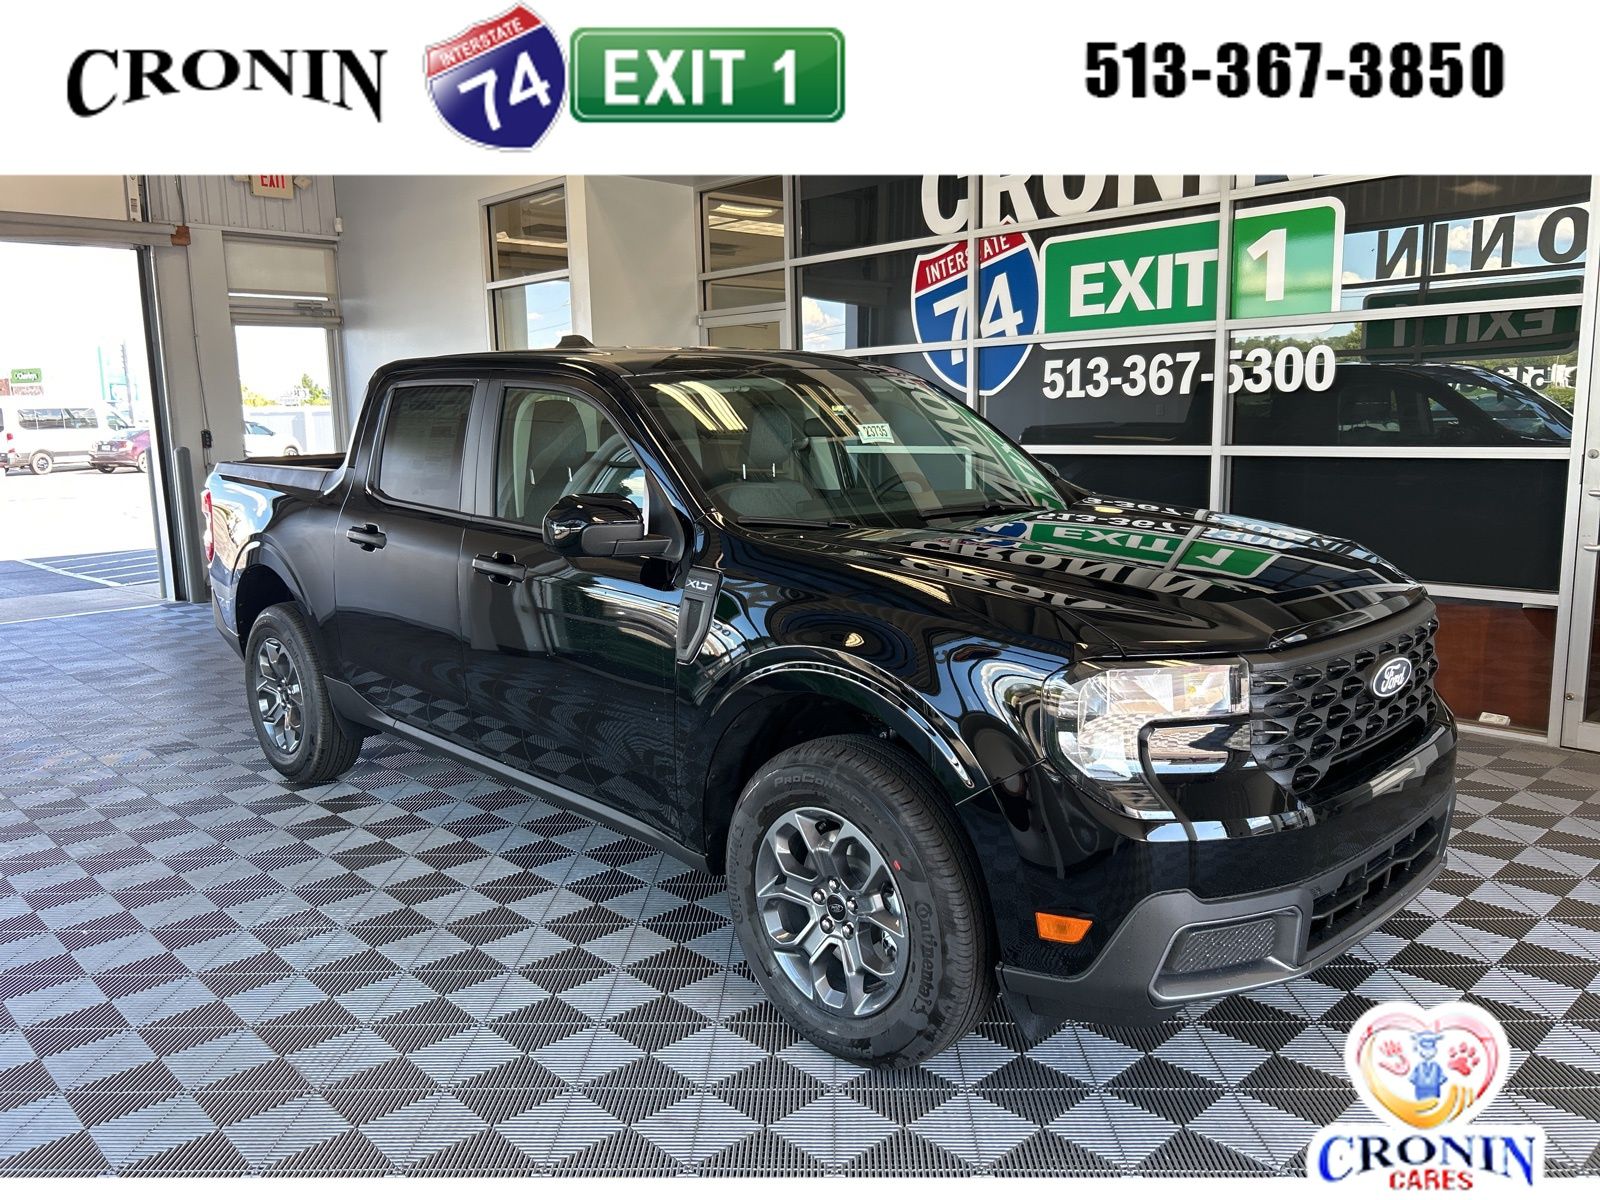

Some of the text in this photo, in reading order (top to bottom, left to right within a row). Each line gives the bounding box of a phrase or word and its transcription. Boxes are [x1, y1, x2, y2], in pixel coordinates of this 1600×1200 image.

[921, 175, 1316, 235] CRO
[925, 235, 1011, 285] INTERATE
[1068, 227, 1287, 317] EXIT 1
[933, 272, 1024, 366] 74
[1042, 344, 1336, 399] 513-367-5300
[863, 425, 888, 438] 23735
[685, 579, 713, 591] XLT
[1380, 662, 1407, 693] Ford
